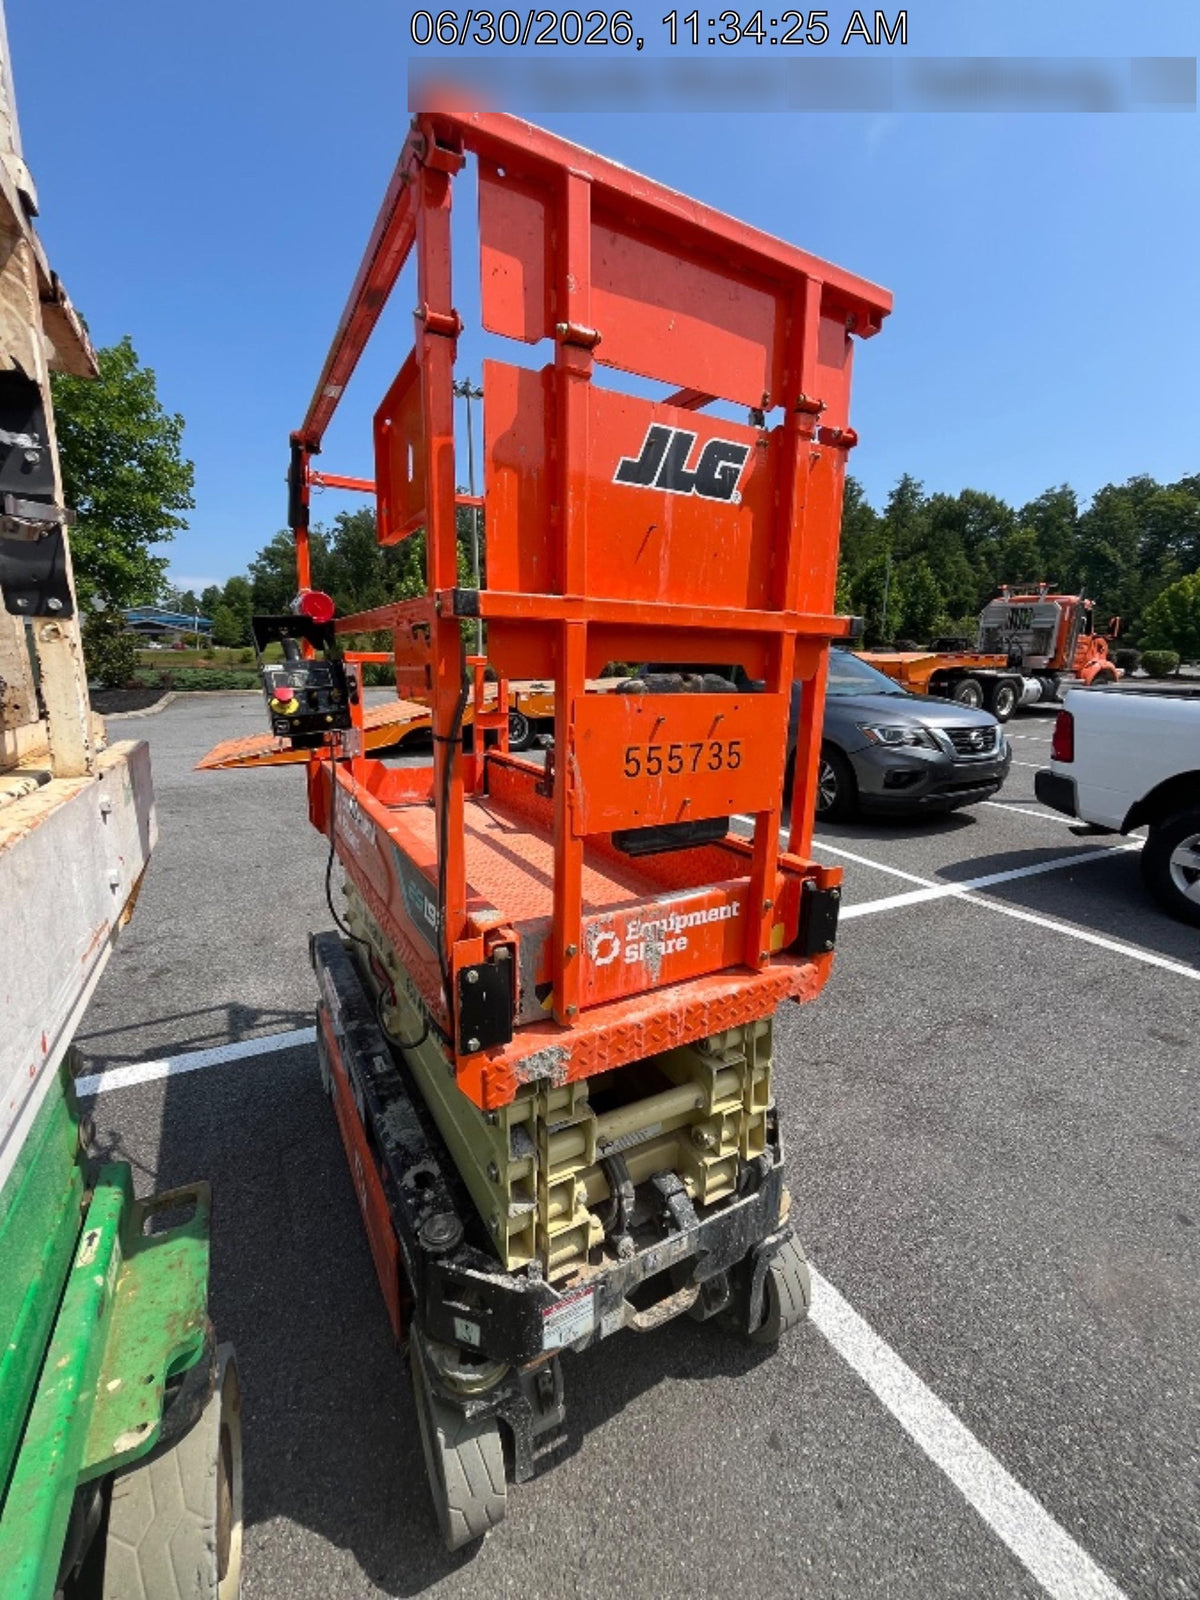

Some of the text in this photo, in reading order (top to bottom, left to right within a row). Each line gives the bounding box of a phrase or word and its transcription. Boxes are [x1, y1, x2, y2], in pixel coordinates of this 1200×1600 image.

[611, 421, 752, 504] JLG
[623, 740, 741, 778] 555735
[625, 900, 740, 942] Equipment
